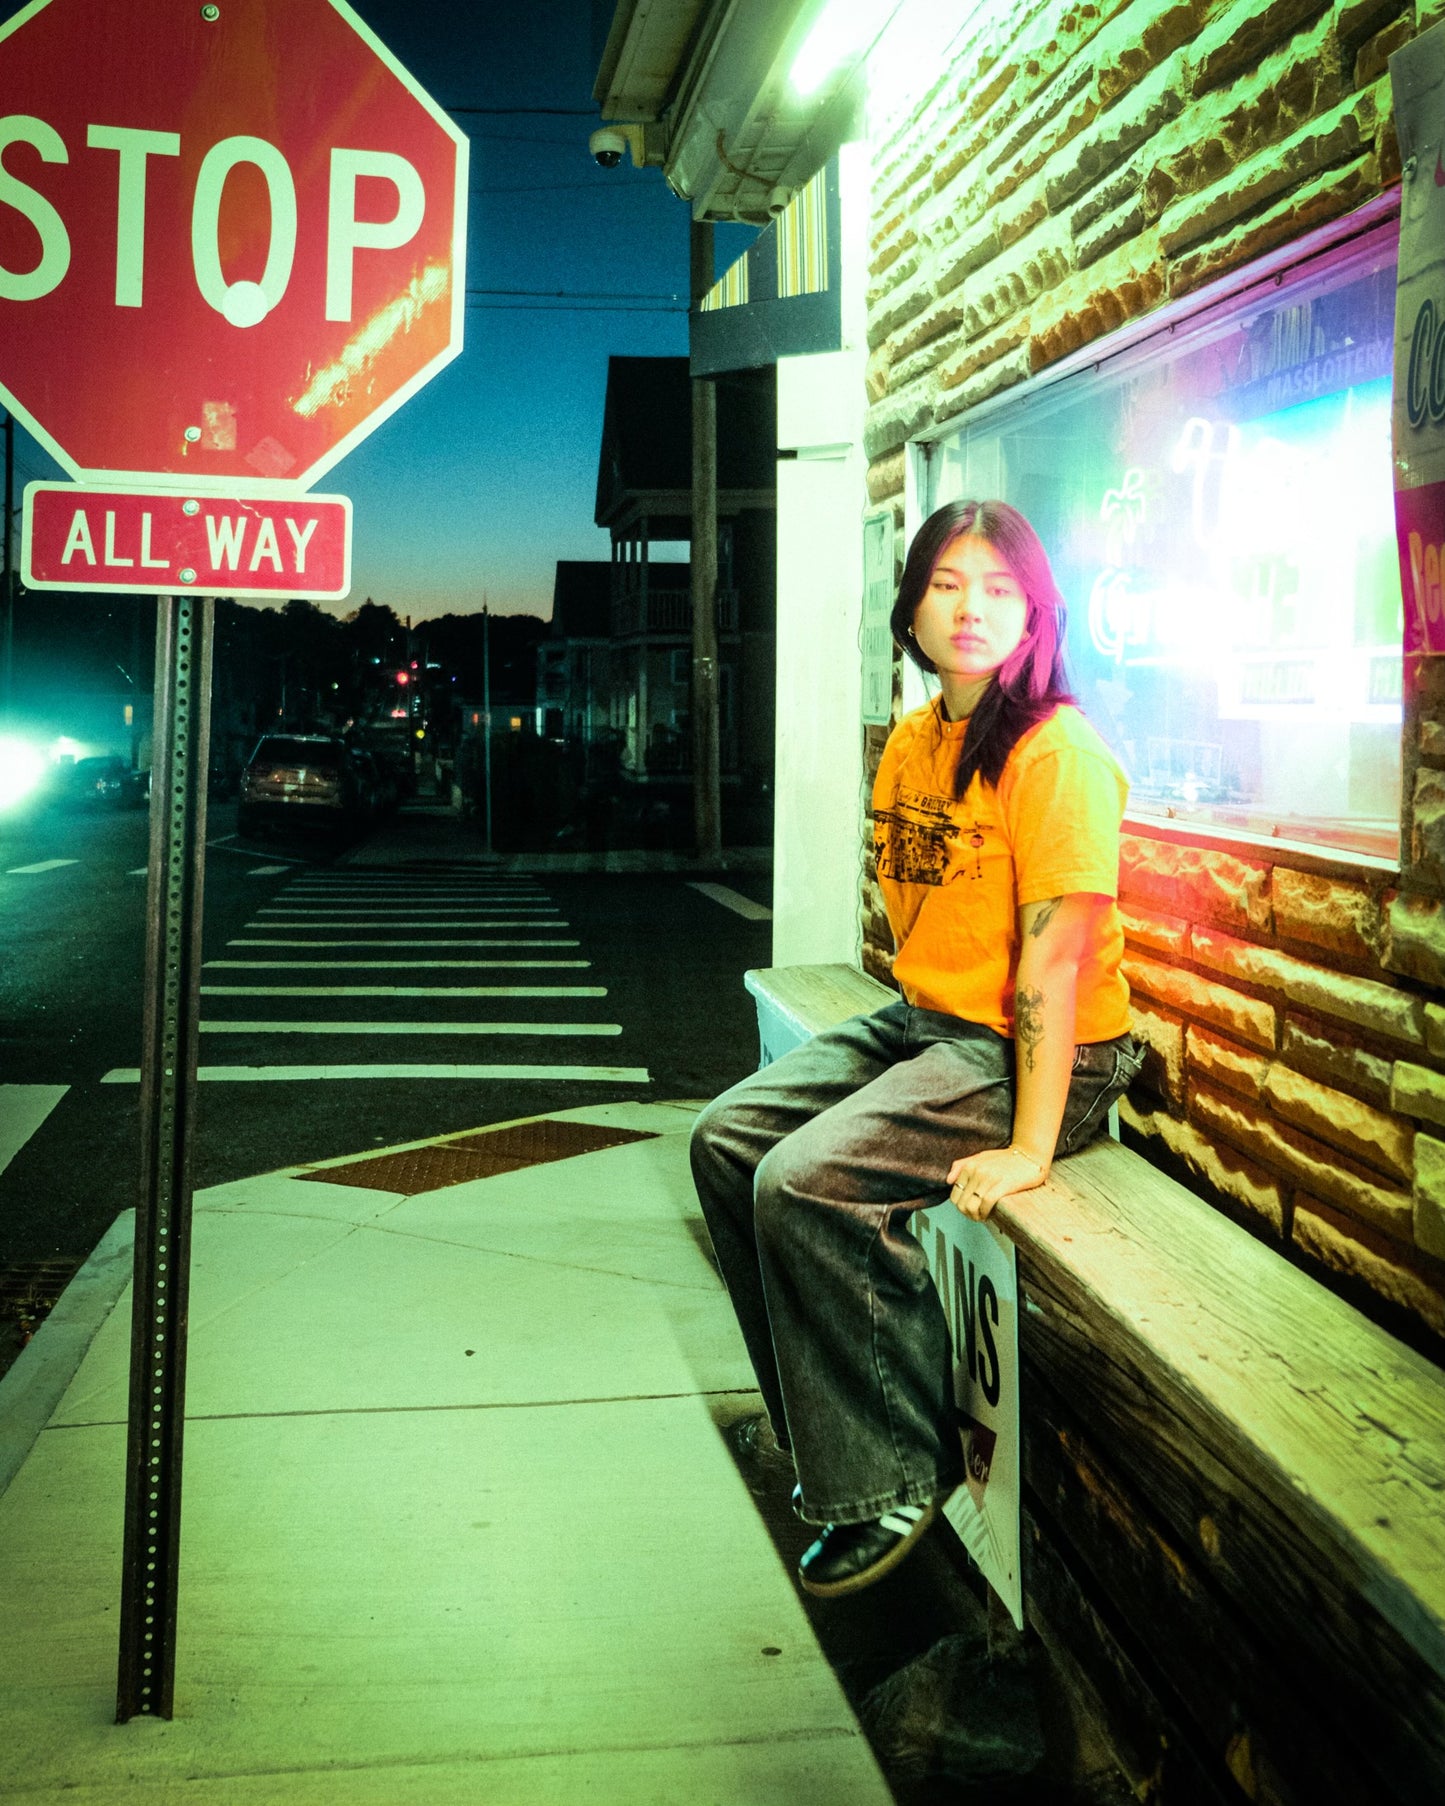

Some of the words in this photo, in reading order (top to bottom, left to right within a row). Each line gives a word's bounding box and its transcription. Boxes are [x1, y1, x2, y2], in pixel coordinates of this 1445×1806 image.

[0, 115, 426, 323] STOP
[61, 510, 170, 569] ALL
[205, 515, 319, 573] WAY
